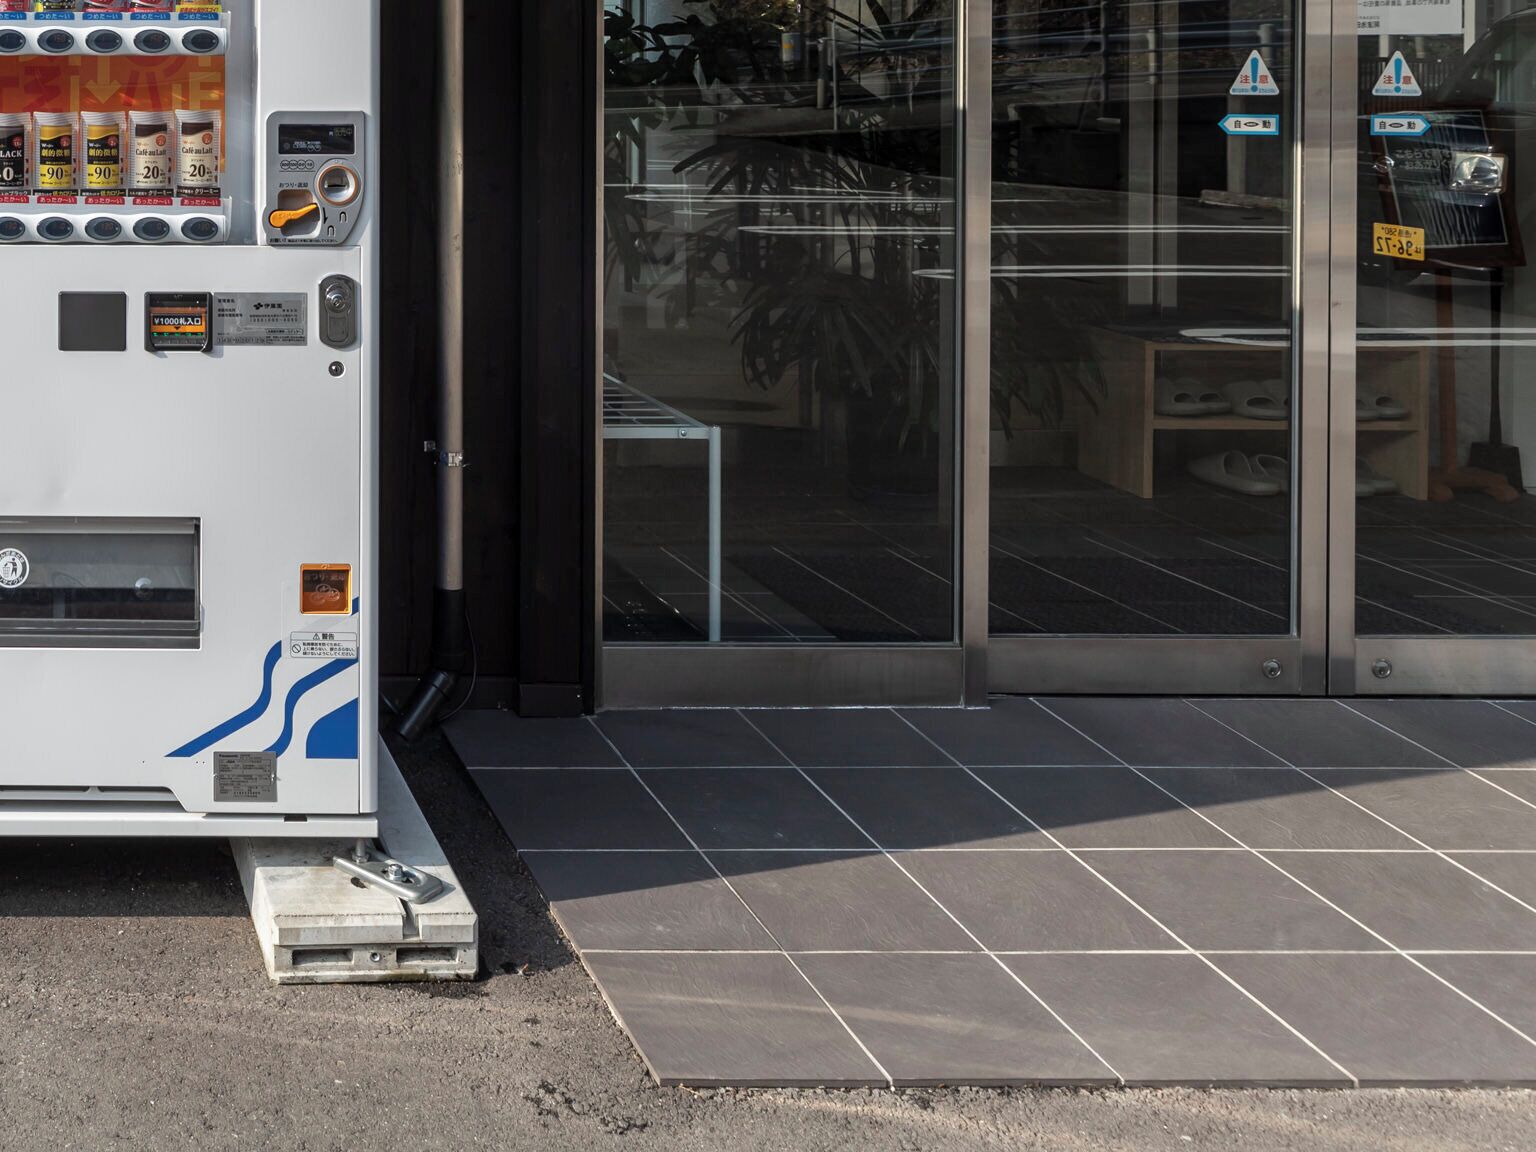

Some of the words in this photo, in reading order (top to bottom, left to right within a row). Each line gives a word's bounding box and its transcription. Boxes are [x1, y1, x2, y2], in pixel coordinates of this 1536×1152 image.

[1240, 74, 1269, 84] 注意
[1383, 74, 1412, 85] 注意
[154, 316, 201, 326] ¥1000札入口
